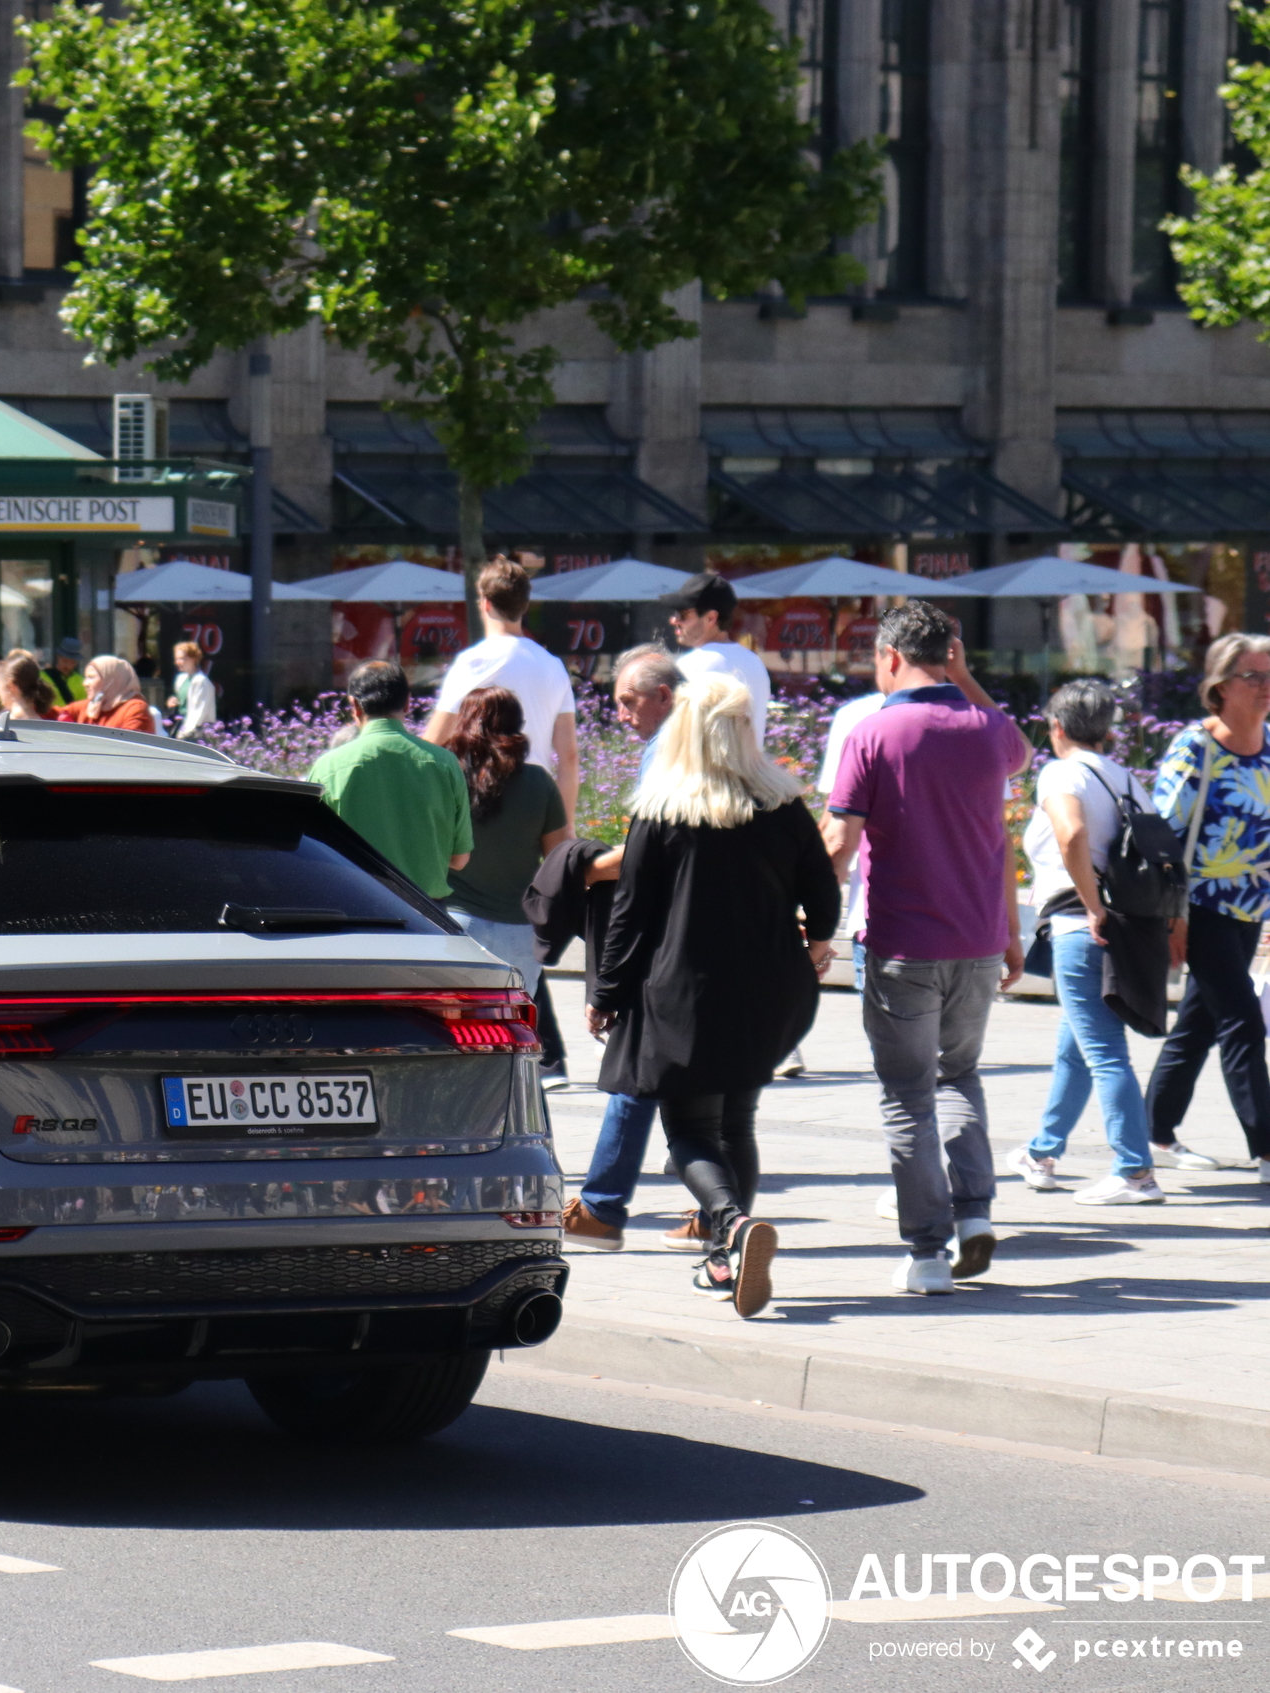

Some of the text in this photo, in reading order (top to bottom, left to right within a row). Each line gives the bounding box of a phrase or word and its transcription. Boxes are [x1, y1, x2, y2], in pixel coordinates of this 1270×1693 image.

[89, 499, 140, 522] POST
[915, 553, 973, 573] FINAL
[182, 623, 223, 655] 70
[567, 619, 605, 651] 70
[186, 1081, 369, 1121] EU CC 8537
[173, 1107, 181, 1119] D
[247, 1127, 277, 1135] deisenroth
[283, 1126, 305, 1134] soehne
